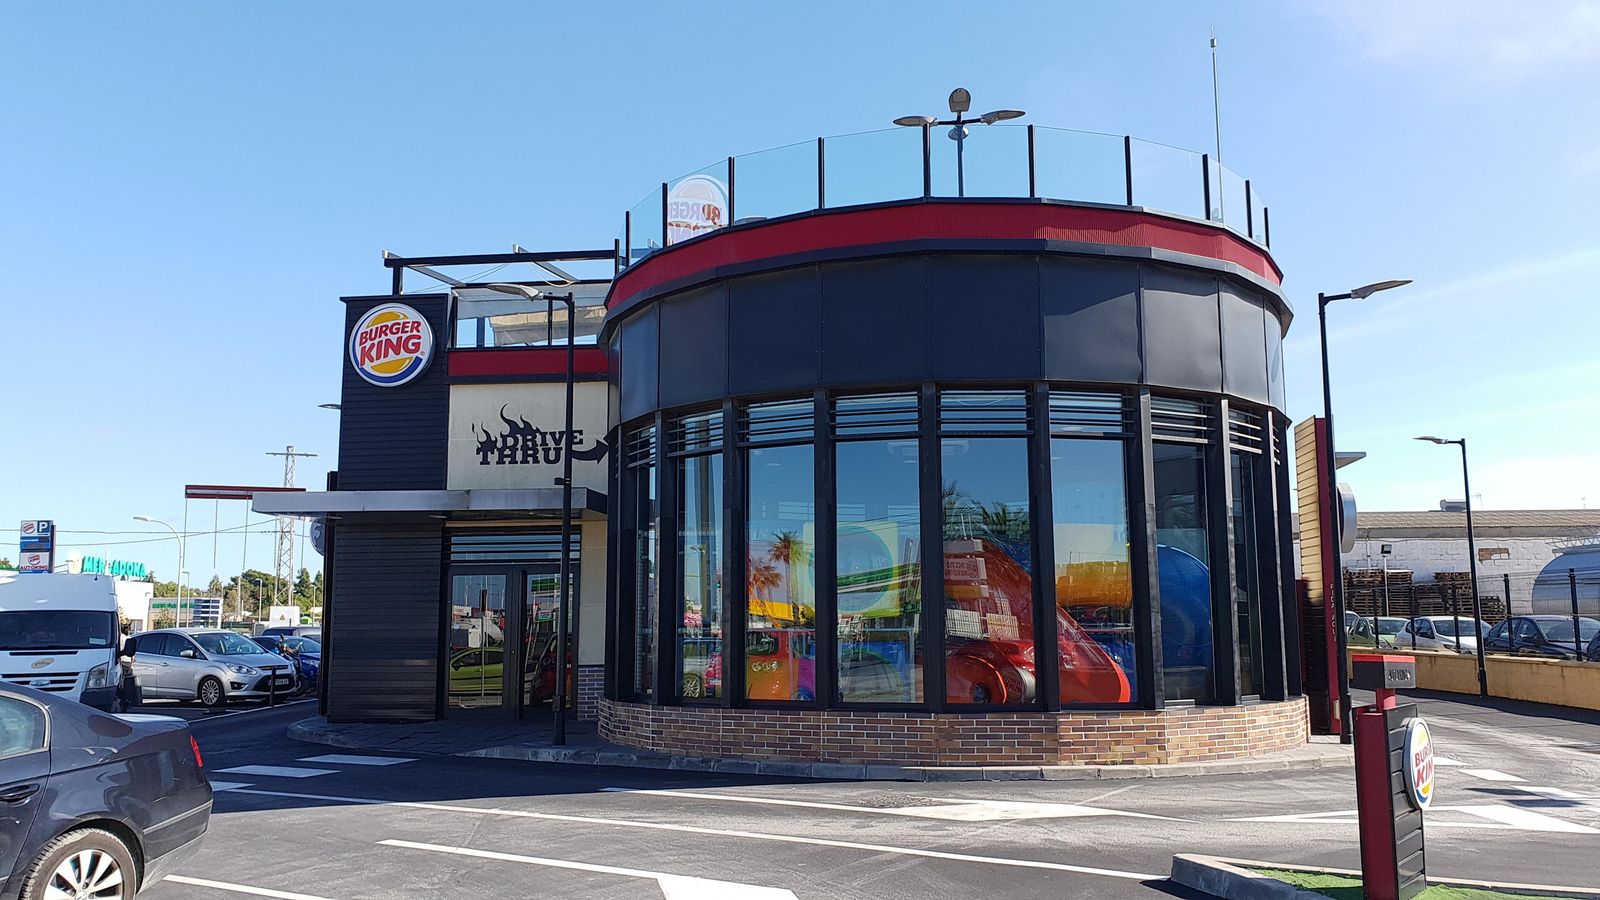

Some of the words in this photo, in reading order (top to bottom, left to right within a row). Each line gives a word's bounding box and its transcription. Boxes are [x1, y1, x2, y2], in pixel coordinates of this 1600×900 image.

[359, 321, 422, 347] BURGER
[360, 334, 422, 367] KING
[500, 429, 584, 448] DRIVE
[476, 446, 563, 465] THRU
[39, 522, 48, 532] P
